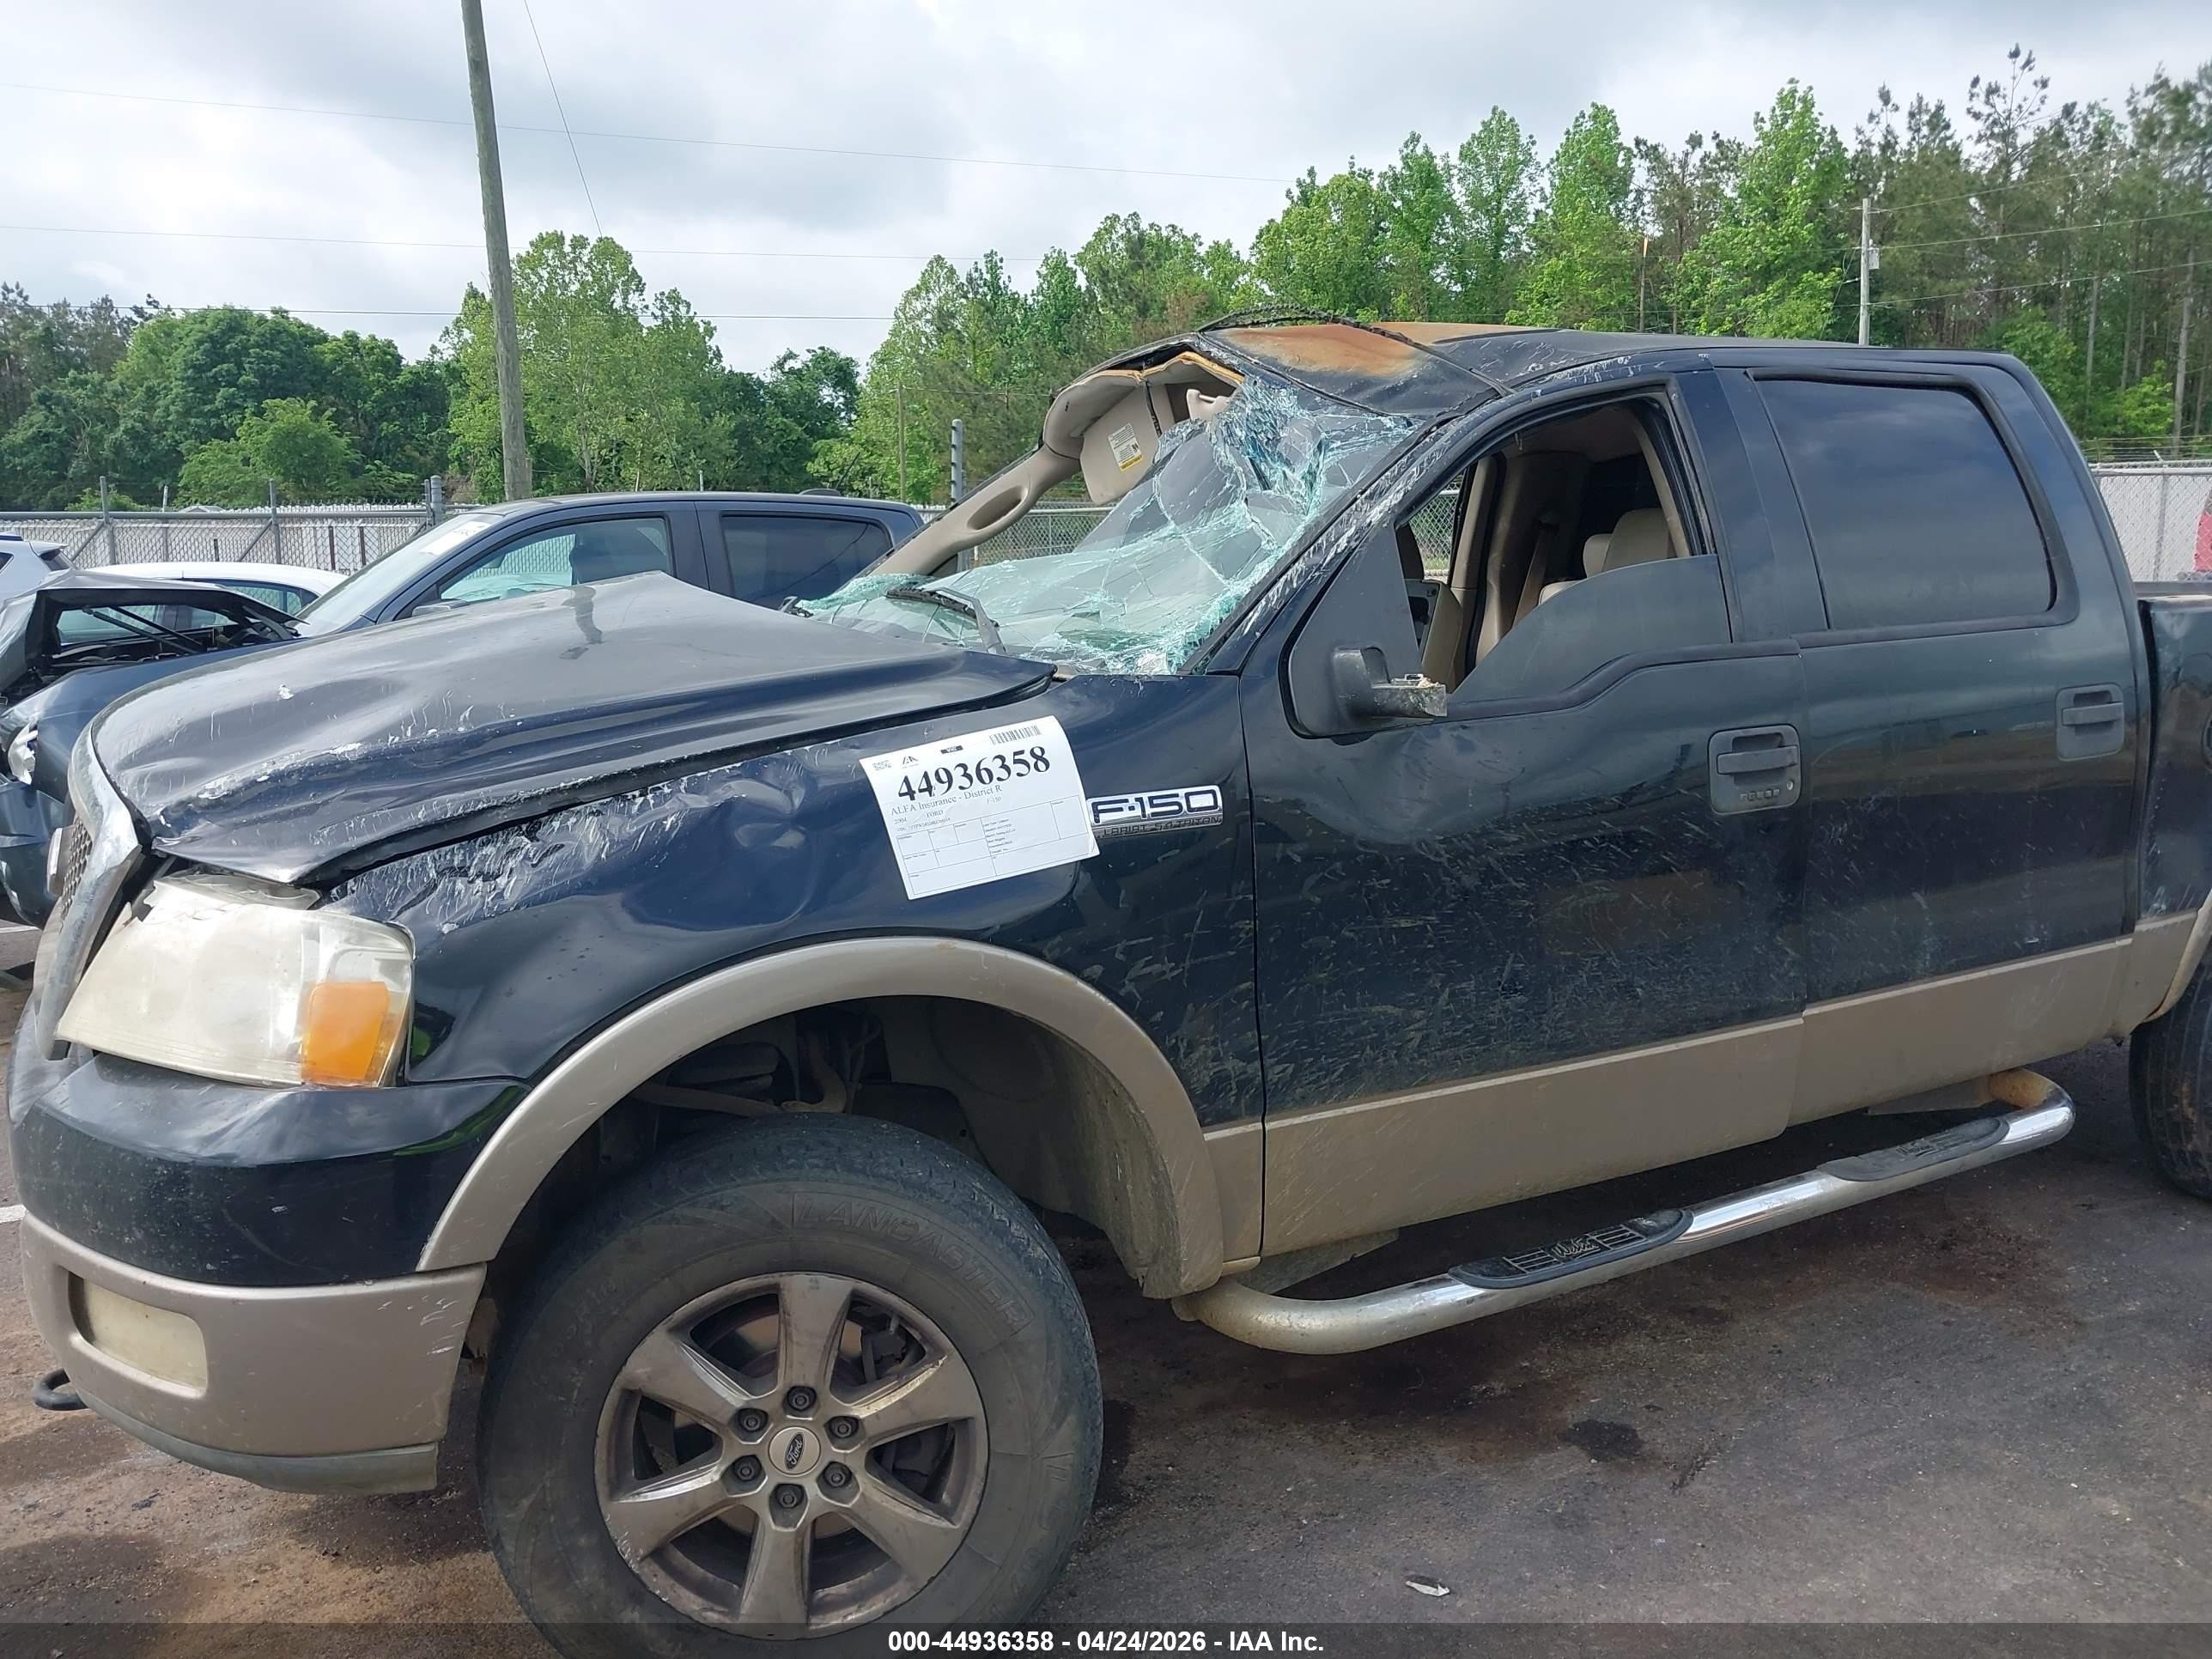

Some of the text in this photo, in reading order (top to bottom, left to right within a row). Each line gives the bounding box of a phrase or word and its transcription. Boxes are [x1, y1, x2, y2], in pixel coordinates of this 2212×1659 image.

[898, 746, 1050, 801] 44936358
[891, 804, 917, 816] ALFA
[918, 797, 957, 811] Insurance
[963, 787, 994, 799] District
[1103, 825, 1146, 836] LARIAT
[787, 1437, 804, 1465] Ford
